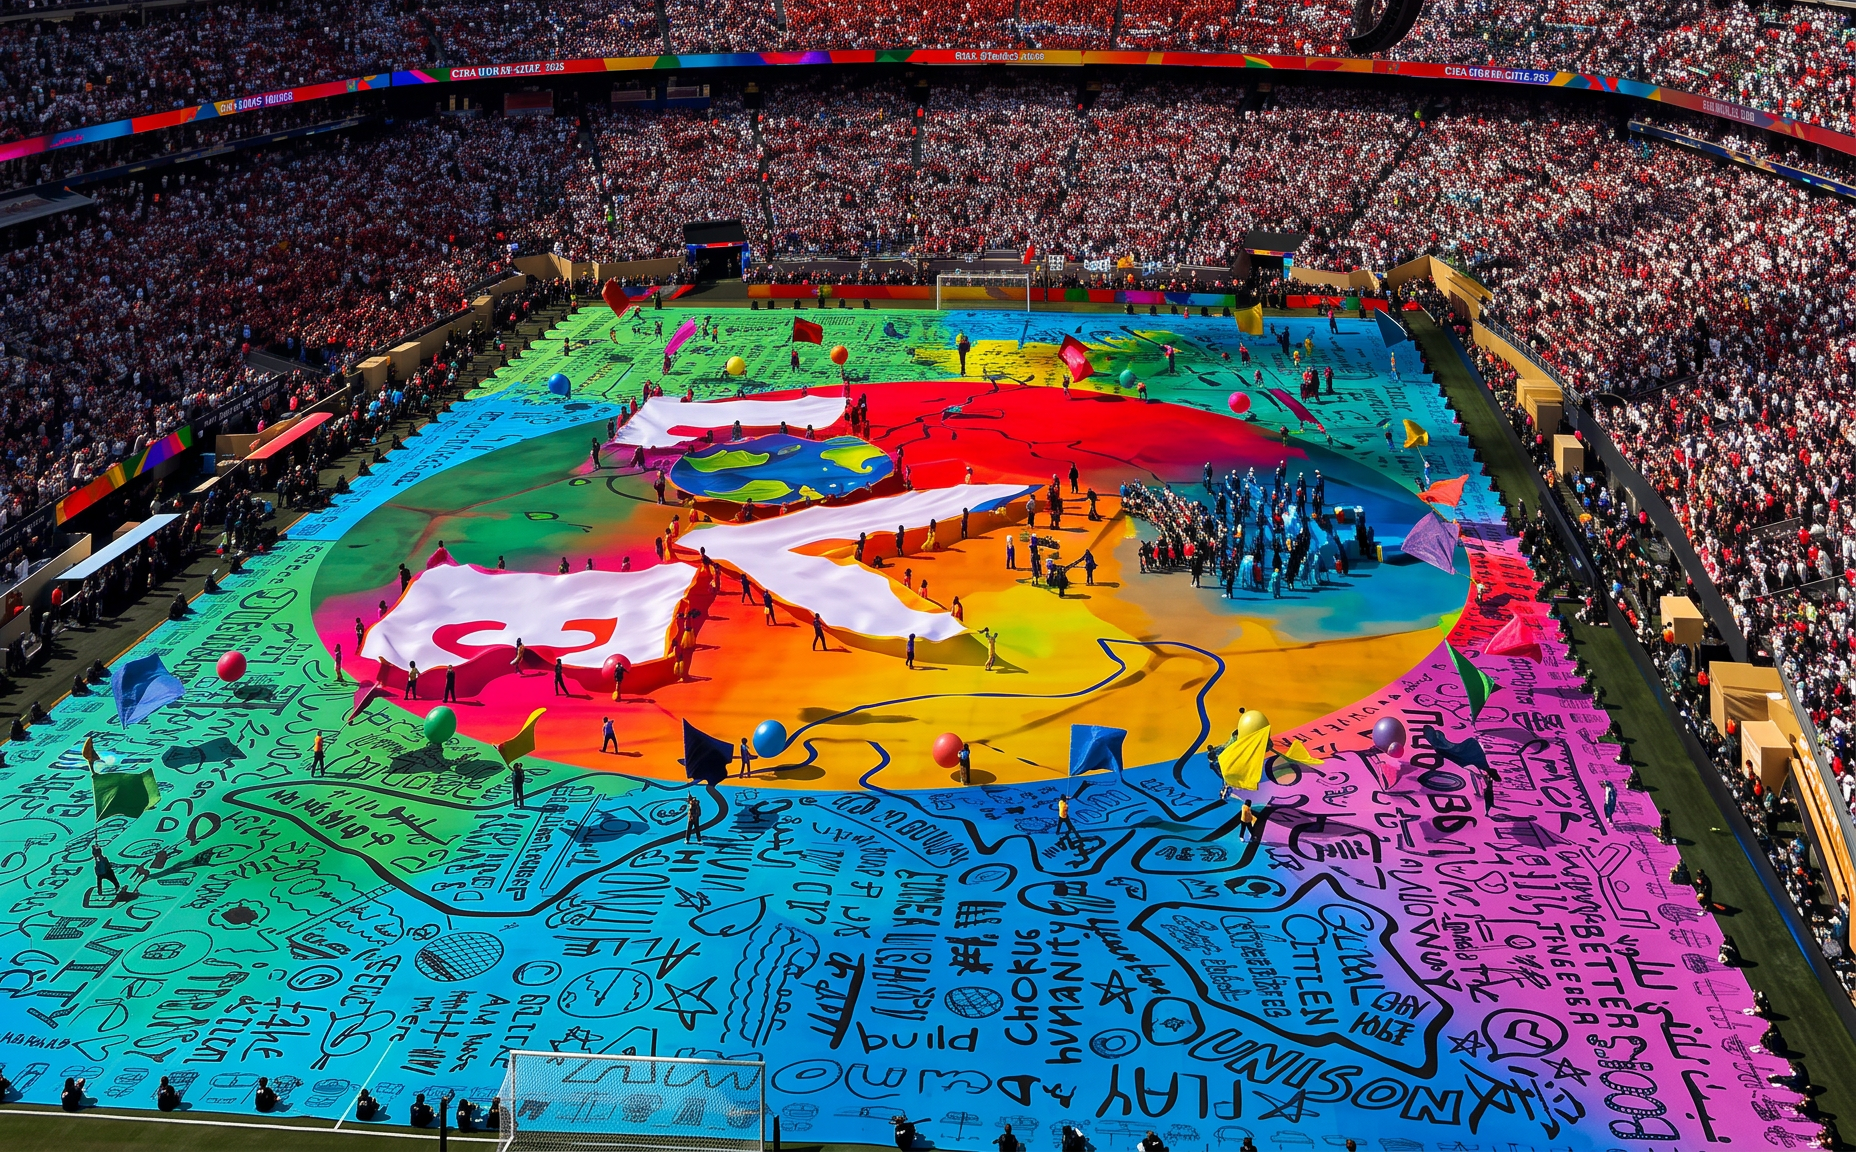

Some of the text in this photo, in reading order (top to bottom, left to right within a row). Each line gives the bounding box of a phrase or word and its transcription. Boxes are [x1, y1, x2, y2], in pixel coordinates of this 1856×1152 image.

[1570, 923, 1640, 1029] BETTER
[856, 1020, 979, 1055] build
[1095, 1064, 1242, 1121] PLAY
[1188, 1028, 1464, 1126] UNISON
